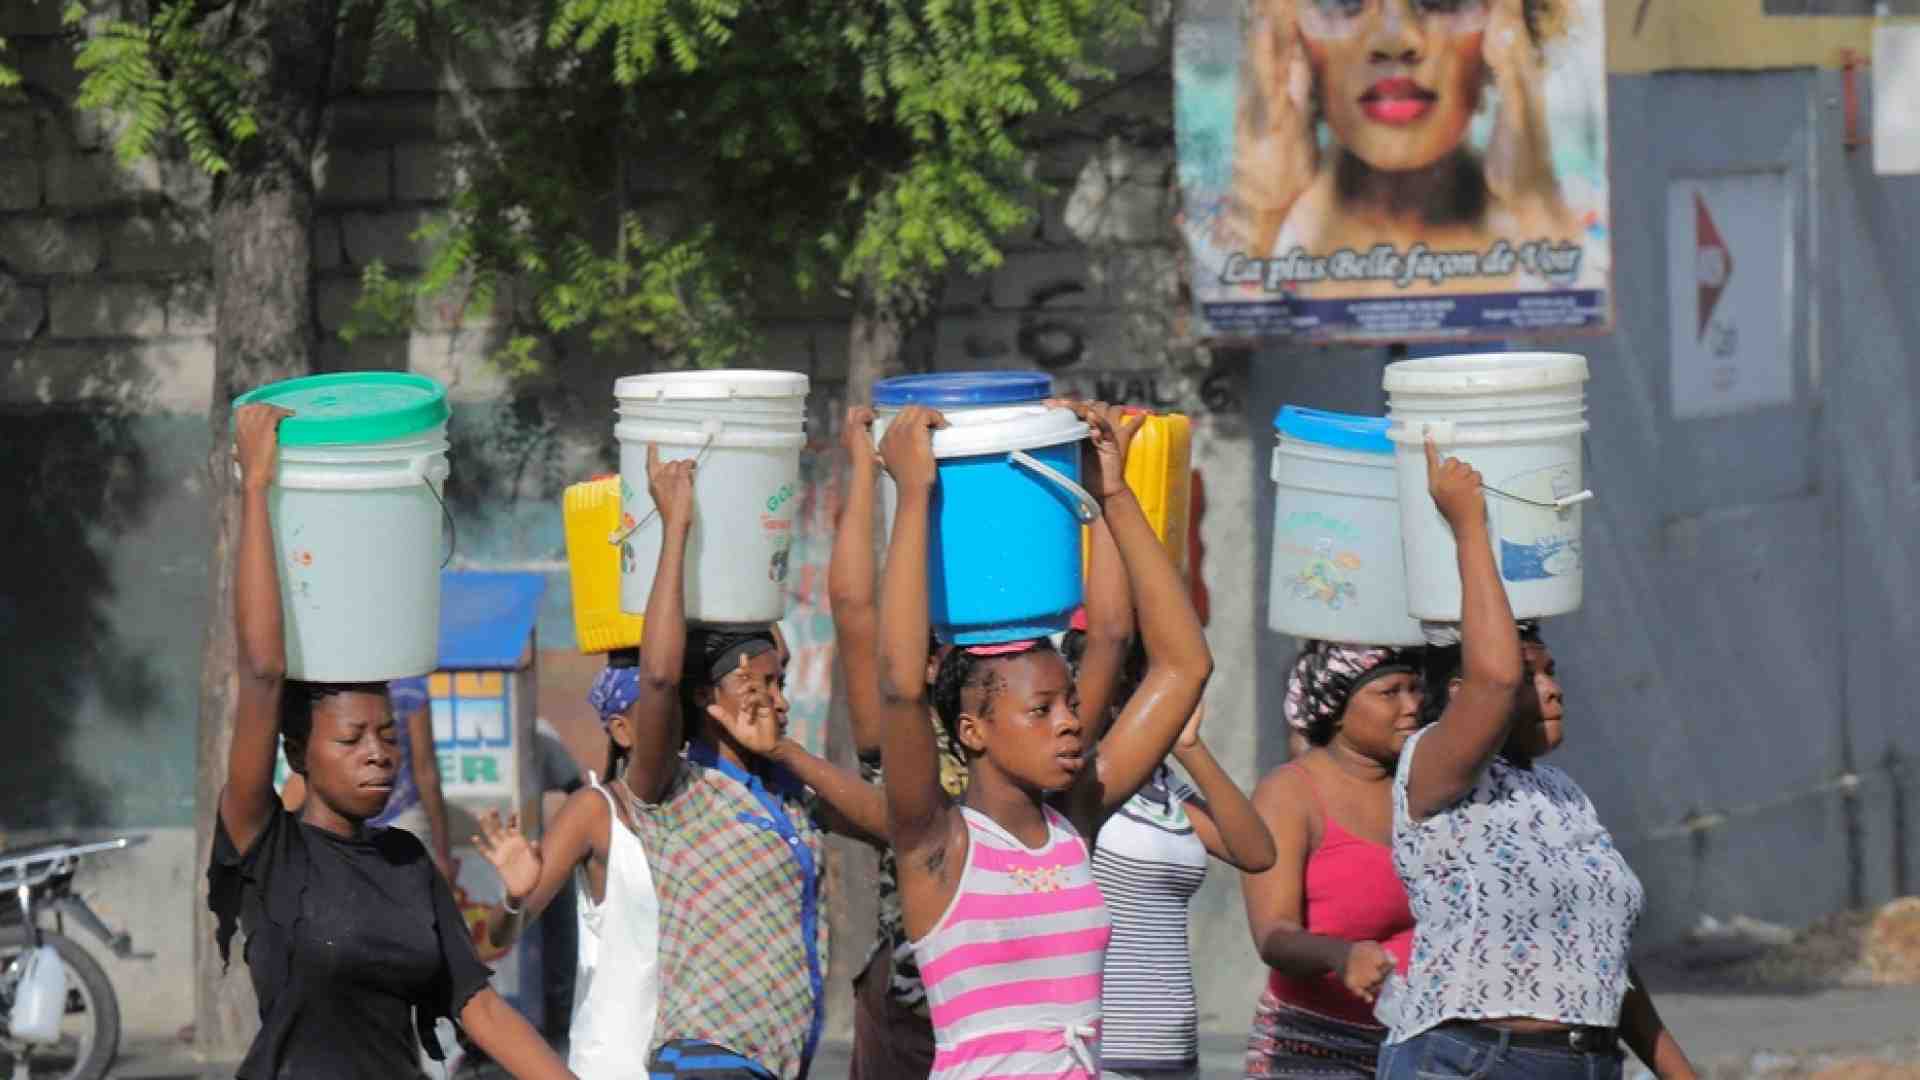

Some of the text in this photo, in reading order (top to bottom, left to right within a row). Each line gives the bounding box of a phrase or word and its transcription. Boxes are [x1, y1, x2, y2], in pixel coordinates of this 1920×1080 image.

[1220, 252, 1264, 285] La
[1264, 246, 1327, 292] plus
[1328, 242, 1399, 280] Belle
[1394, 239, 1479, 288] façon
[1479, 237, 1517, 276] de
